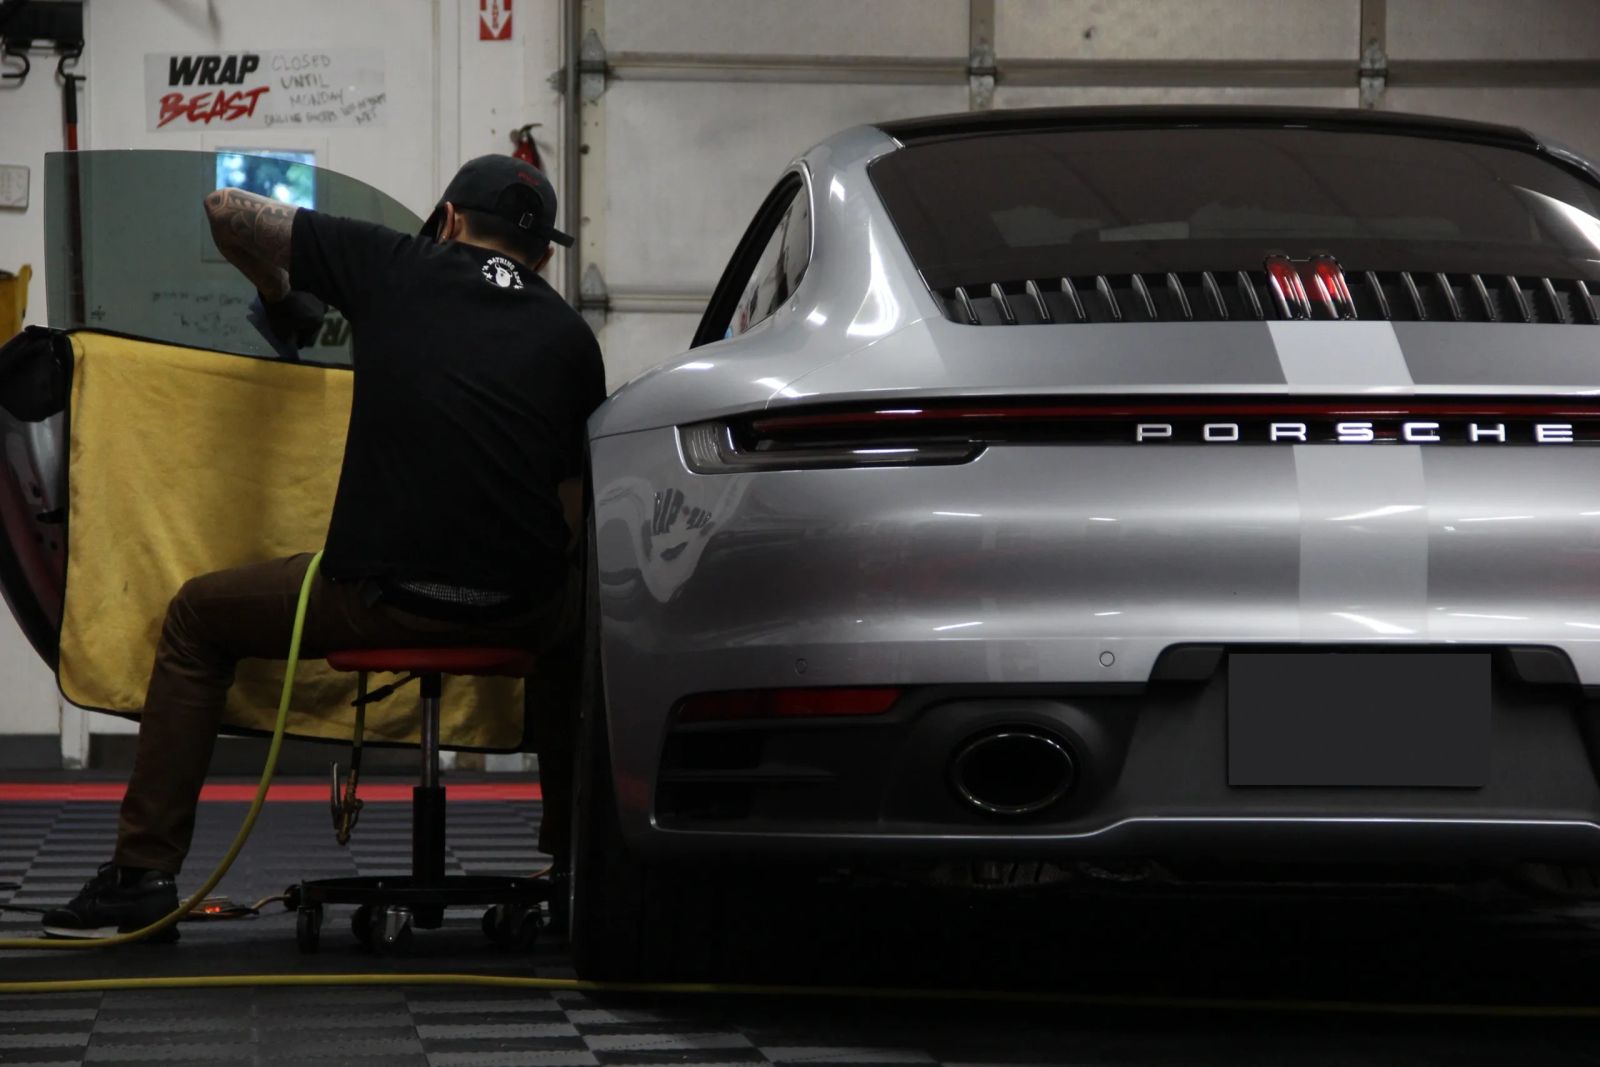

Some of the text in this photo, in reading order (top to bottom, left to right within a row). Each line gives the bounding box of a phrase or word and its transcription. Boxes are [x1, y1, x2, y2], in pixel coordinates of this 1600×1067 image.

[168, 54, 260, 87] WRAP
[271, 53, 332, 72] CLOSED
[280, 73, 331, 91] UNTIL
[156, 86, 271, 129] BEAST
[289, 88, 344, 108] MONDAY
[486, 256, 515, 271] BATHING
[1136, 422, 1575, 443] PORSCHE
